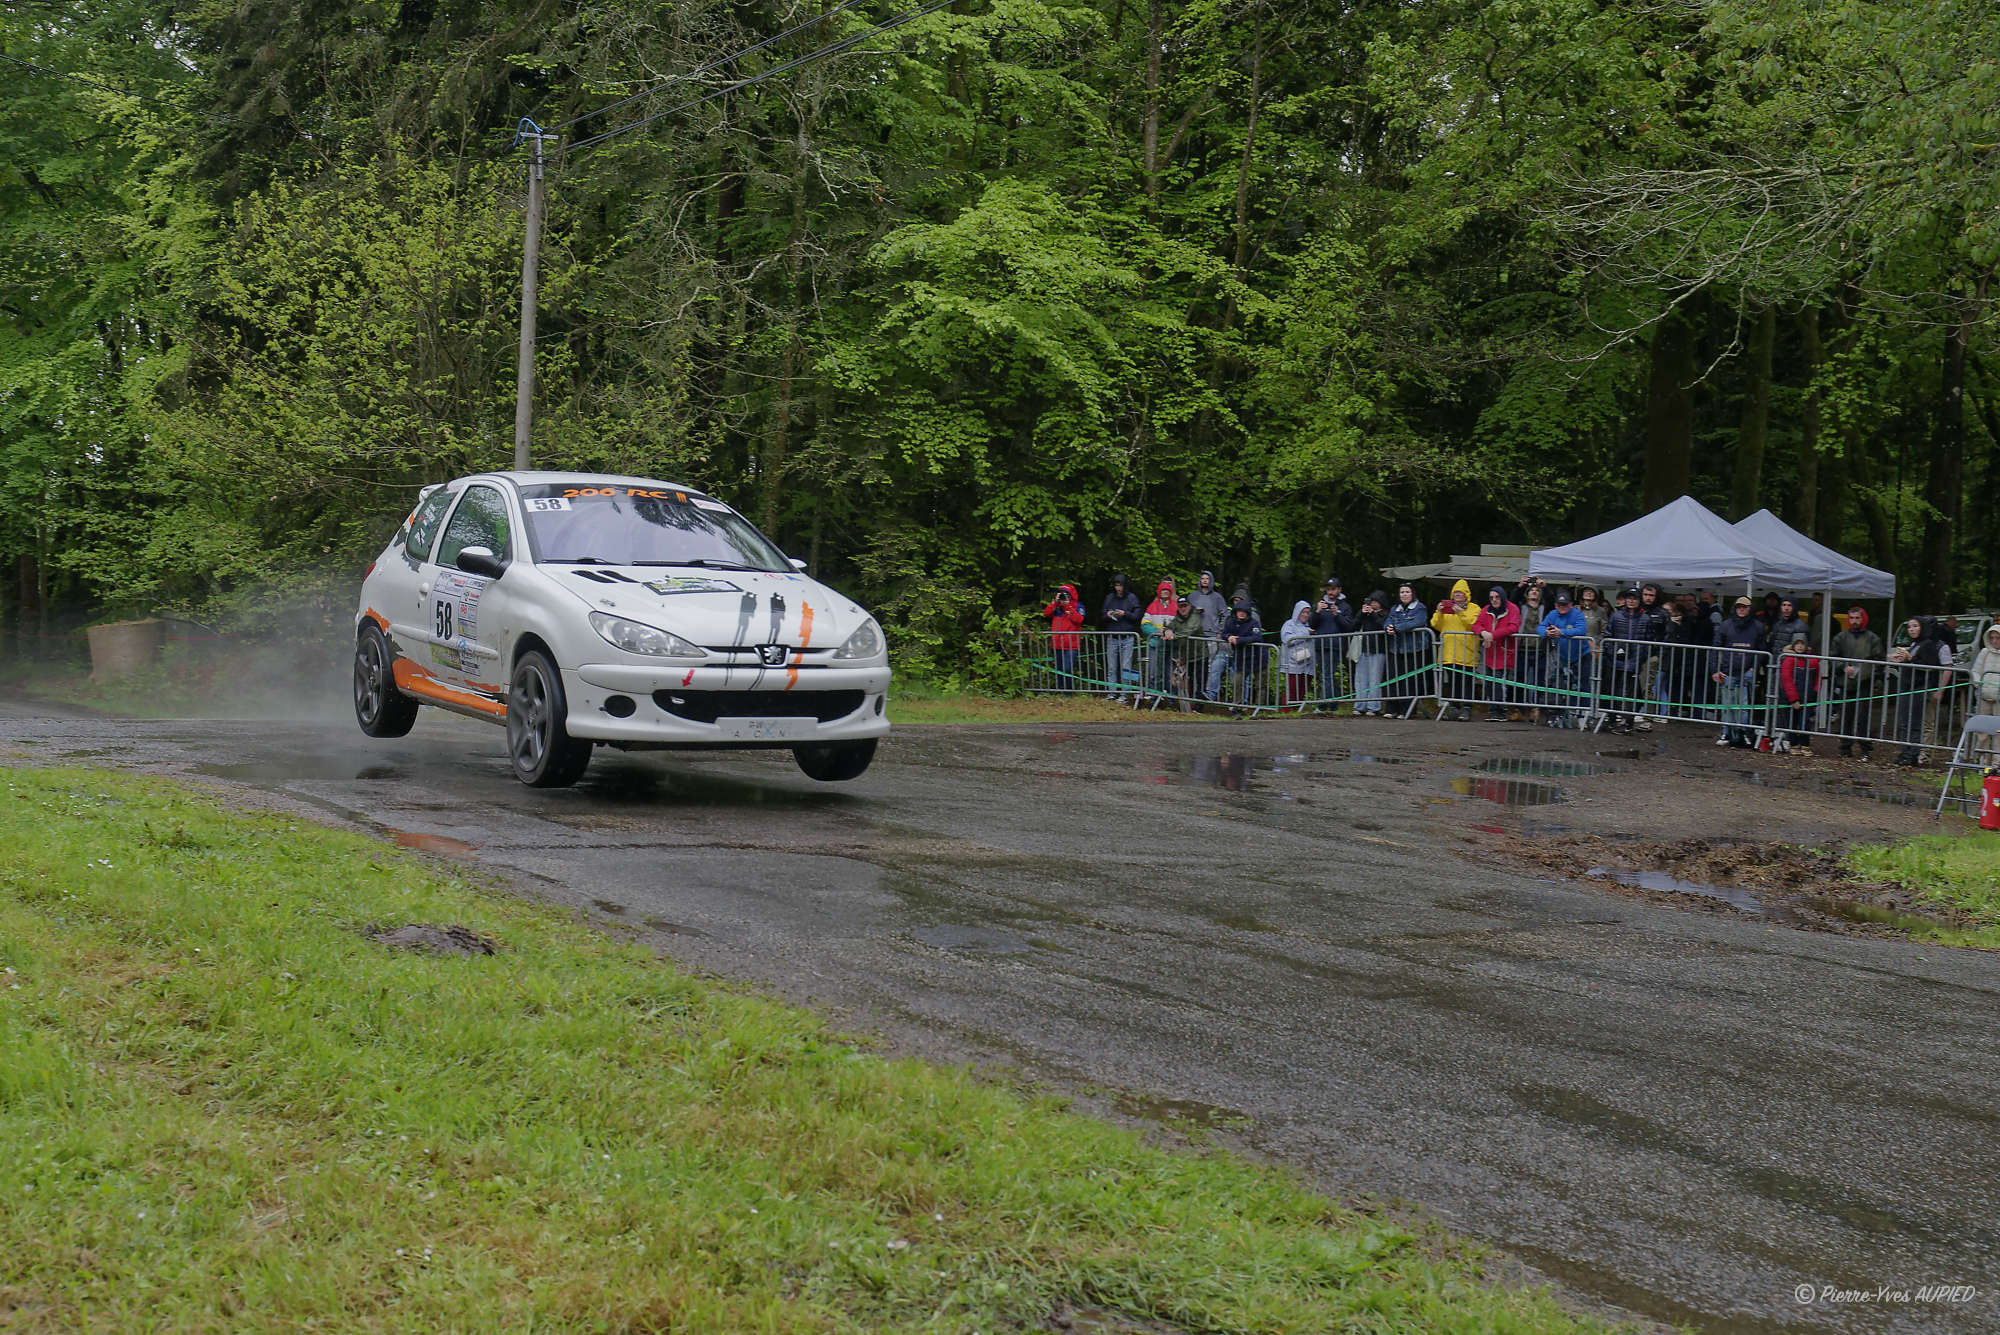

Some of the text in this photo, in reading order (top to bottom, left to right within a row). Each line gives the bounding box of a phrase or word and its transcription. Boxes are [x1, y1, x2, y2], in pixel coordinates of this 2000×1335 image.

[563, 488, 668, 499] 206 RC
[534, 498, 562, 511] 58
[437, 600, 452, 640] 58
